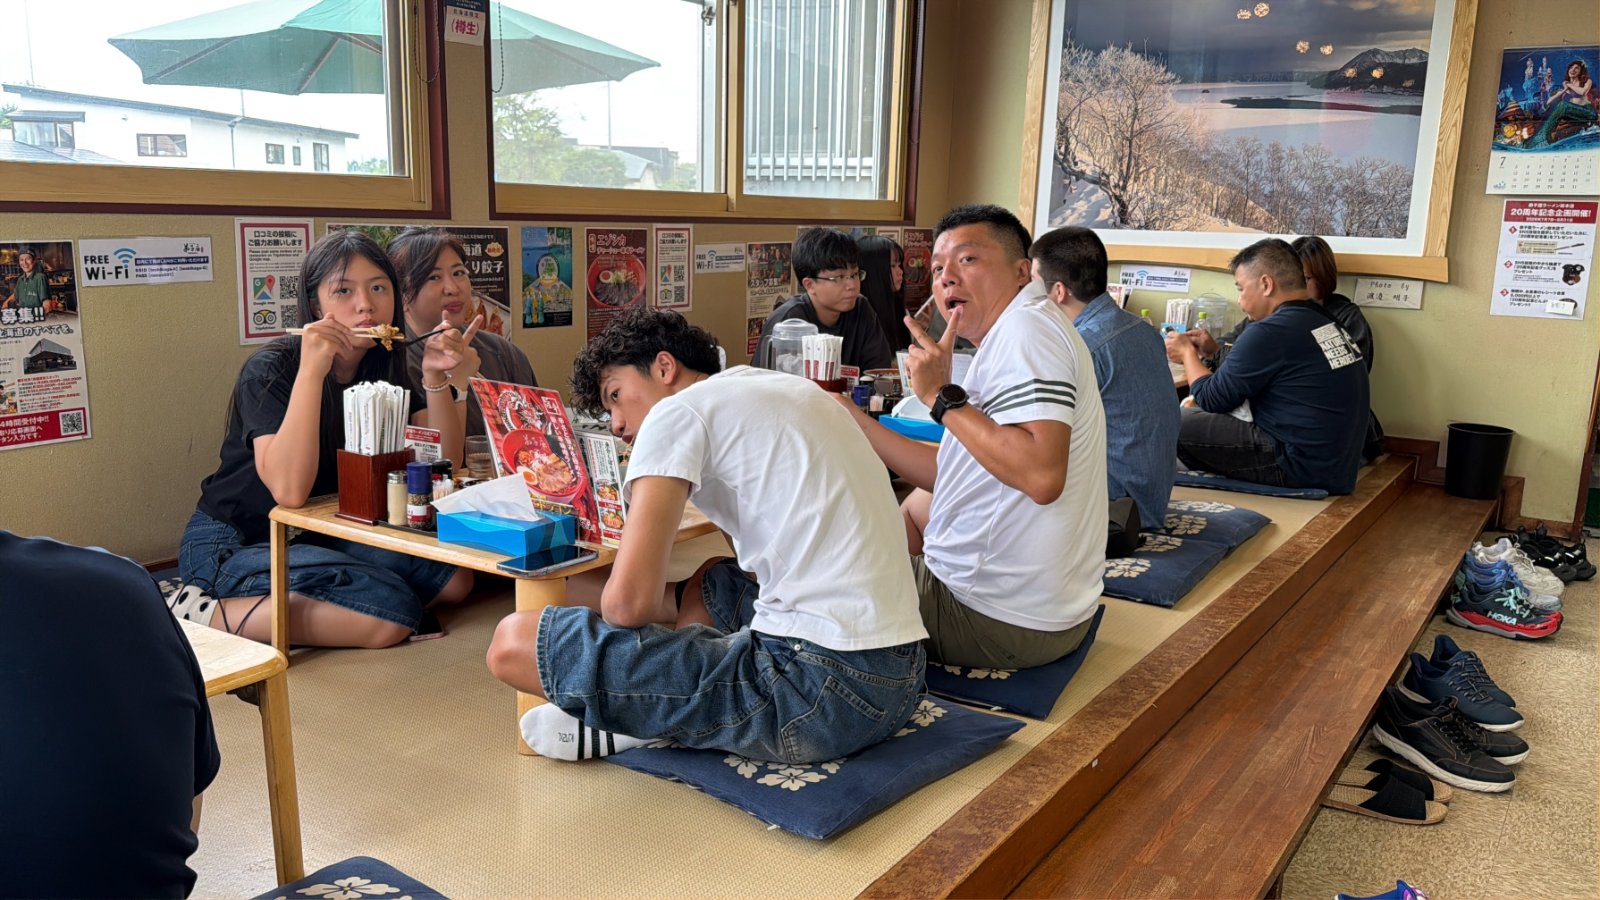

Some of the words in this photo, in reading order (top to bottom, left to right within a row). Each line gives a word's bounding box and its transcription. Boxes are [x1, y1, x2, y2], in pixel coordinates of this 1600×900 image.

[84, 255, 109, 264] FREE
[85, 264, 128, 280] Wi-Fi
[1122, 278, 1143, 286] Wi-Fi
[1, 307, 44, 324] 募集!!
[0, 433, 41, 443] タン入力です。
[1487, 611, 1517, 625] HOKA
